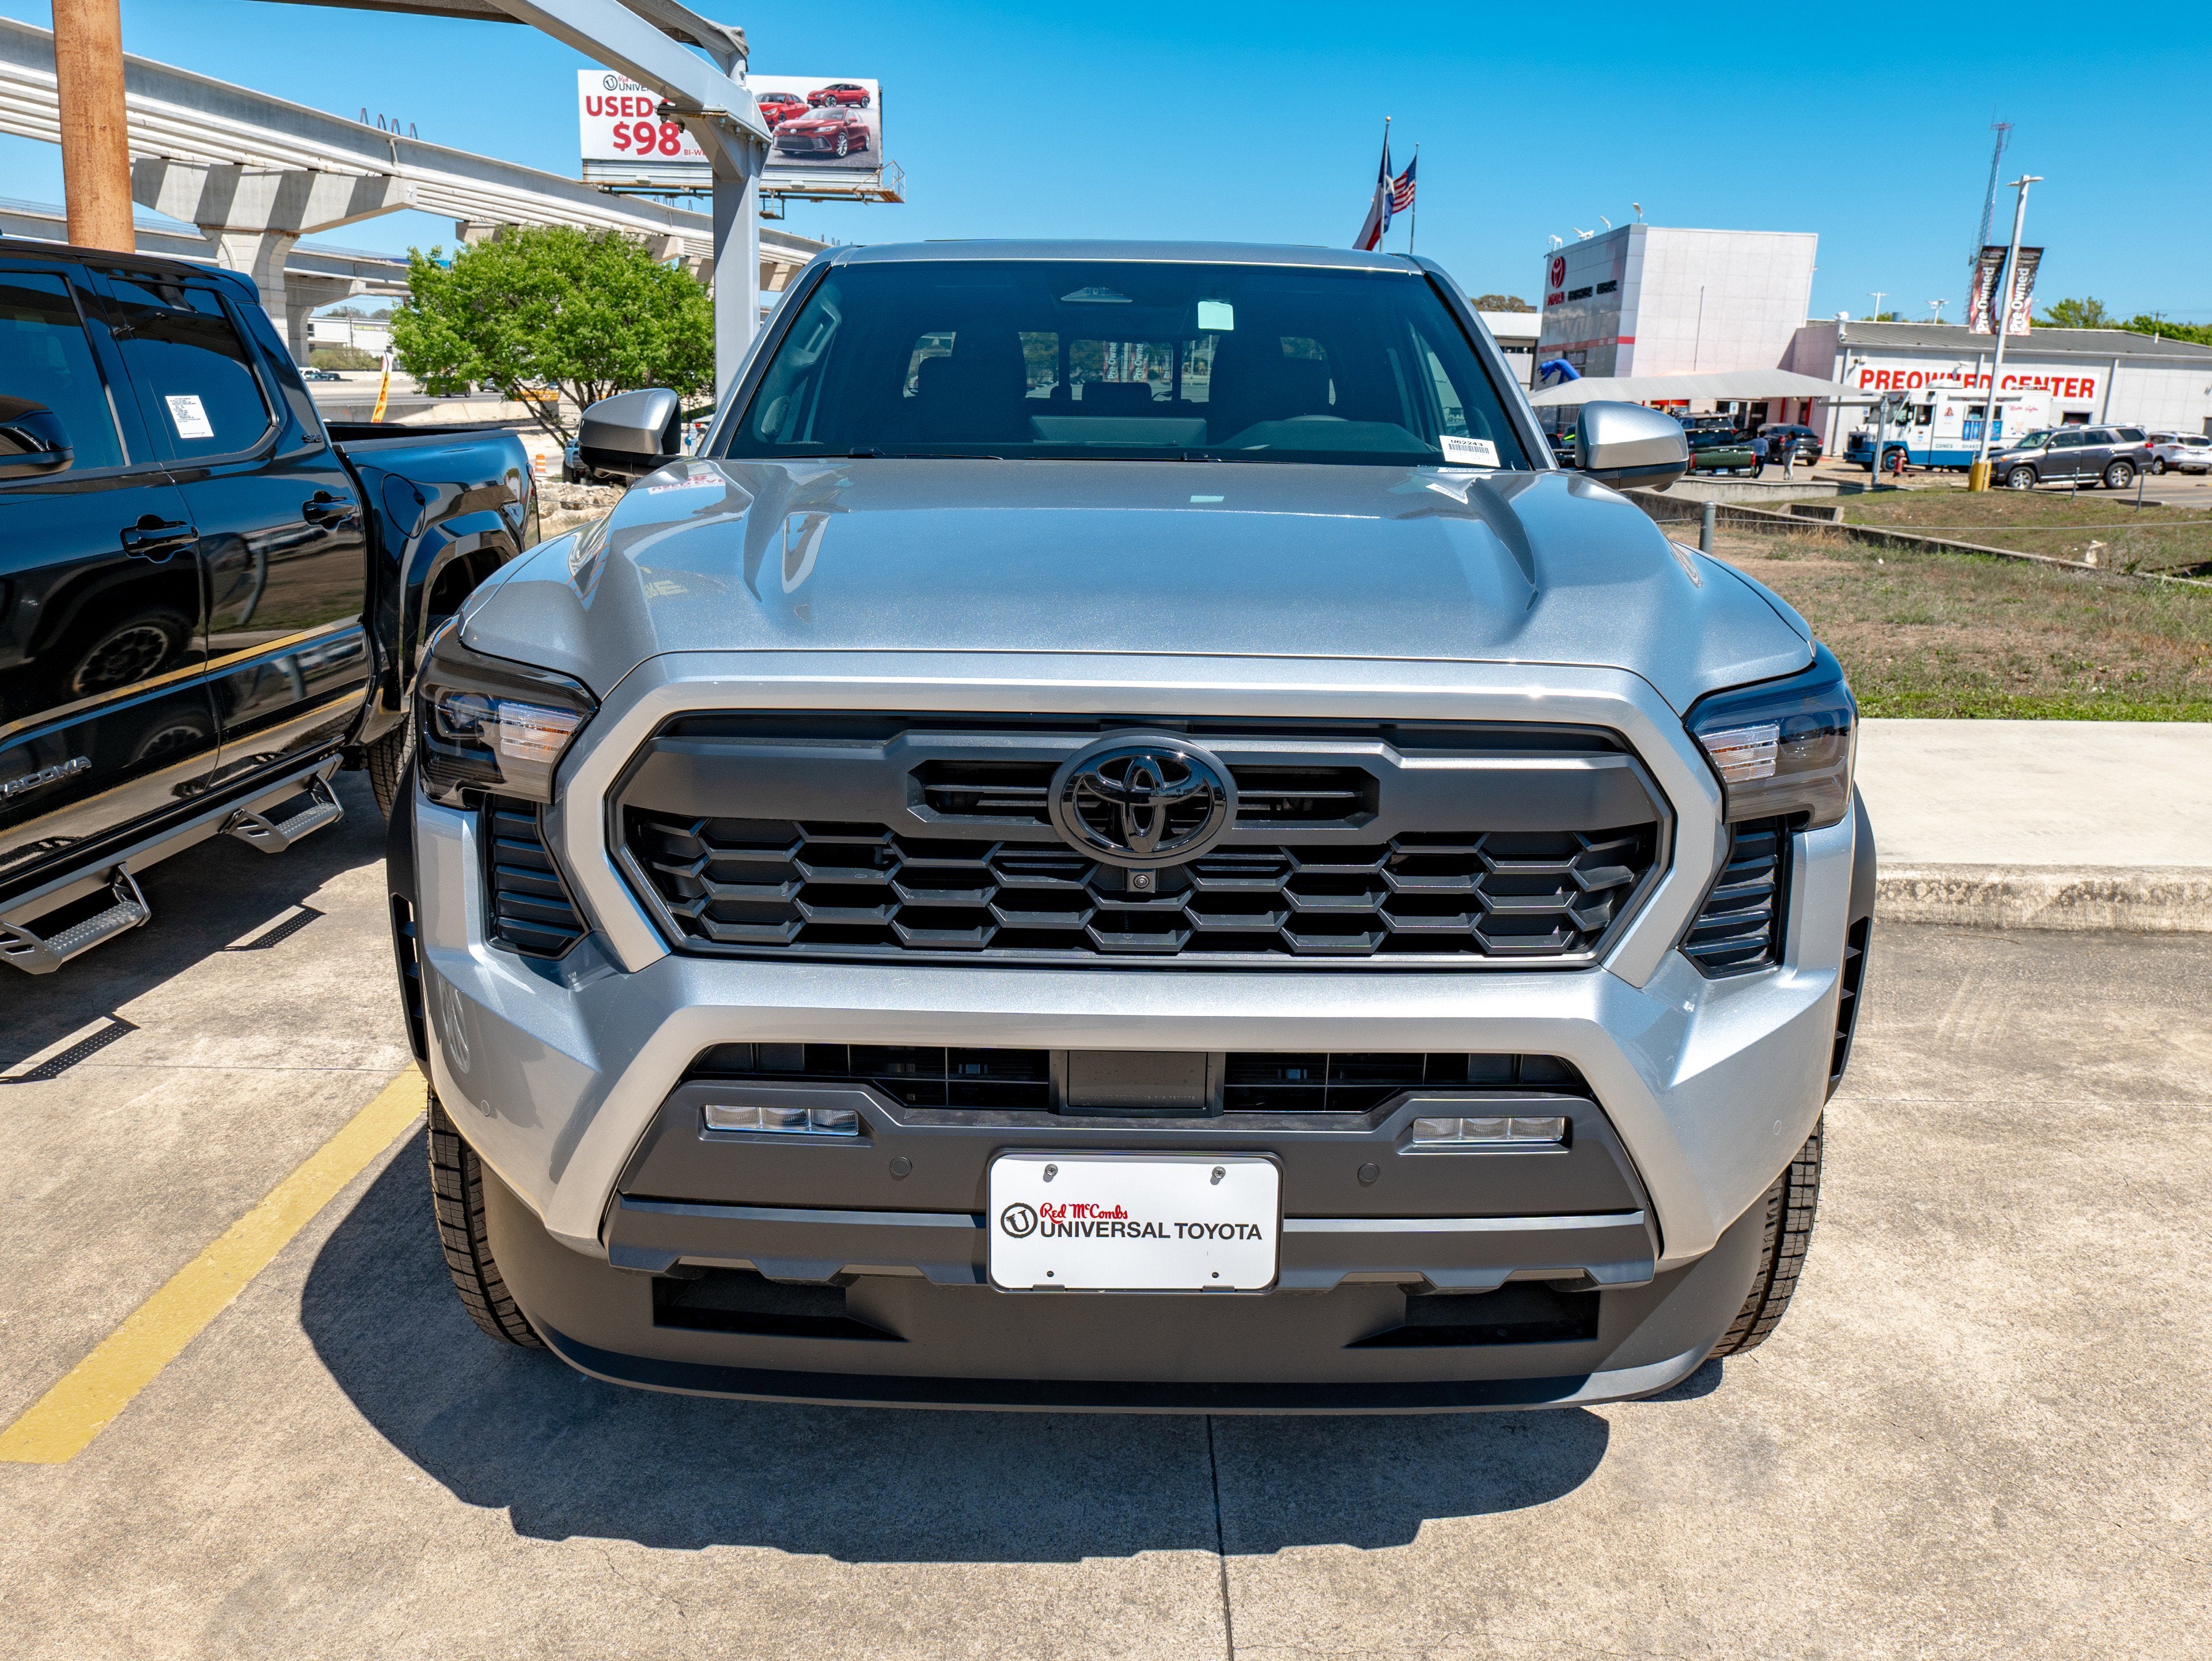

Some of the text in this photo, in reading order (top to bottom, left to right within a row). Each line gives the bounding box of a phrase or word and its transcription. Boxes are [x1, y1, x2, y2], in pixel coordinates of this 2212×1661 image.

[619, 82, 649, 91] UNIVE
[586, 96, 653, 118] USED
[612, 121, 681, 156] $98
[1977, 267, 1996, 310] Owned
[2010, 267, 2031, 310] Owned
[1976, 312, 1989, 332] Pre
[2009, 312, 2023, 332] Pre
[1107, 342, 1116, 379] Pre Owne
[1133, 343, 1144, 380] Pre Owne
[1039, 1202, 1128, 1224] Red McCombs
[1040, 1220, 1263, 1240] UNIVERSAL TOYOTA
